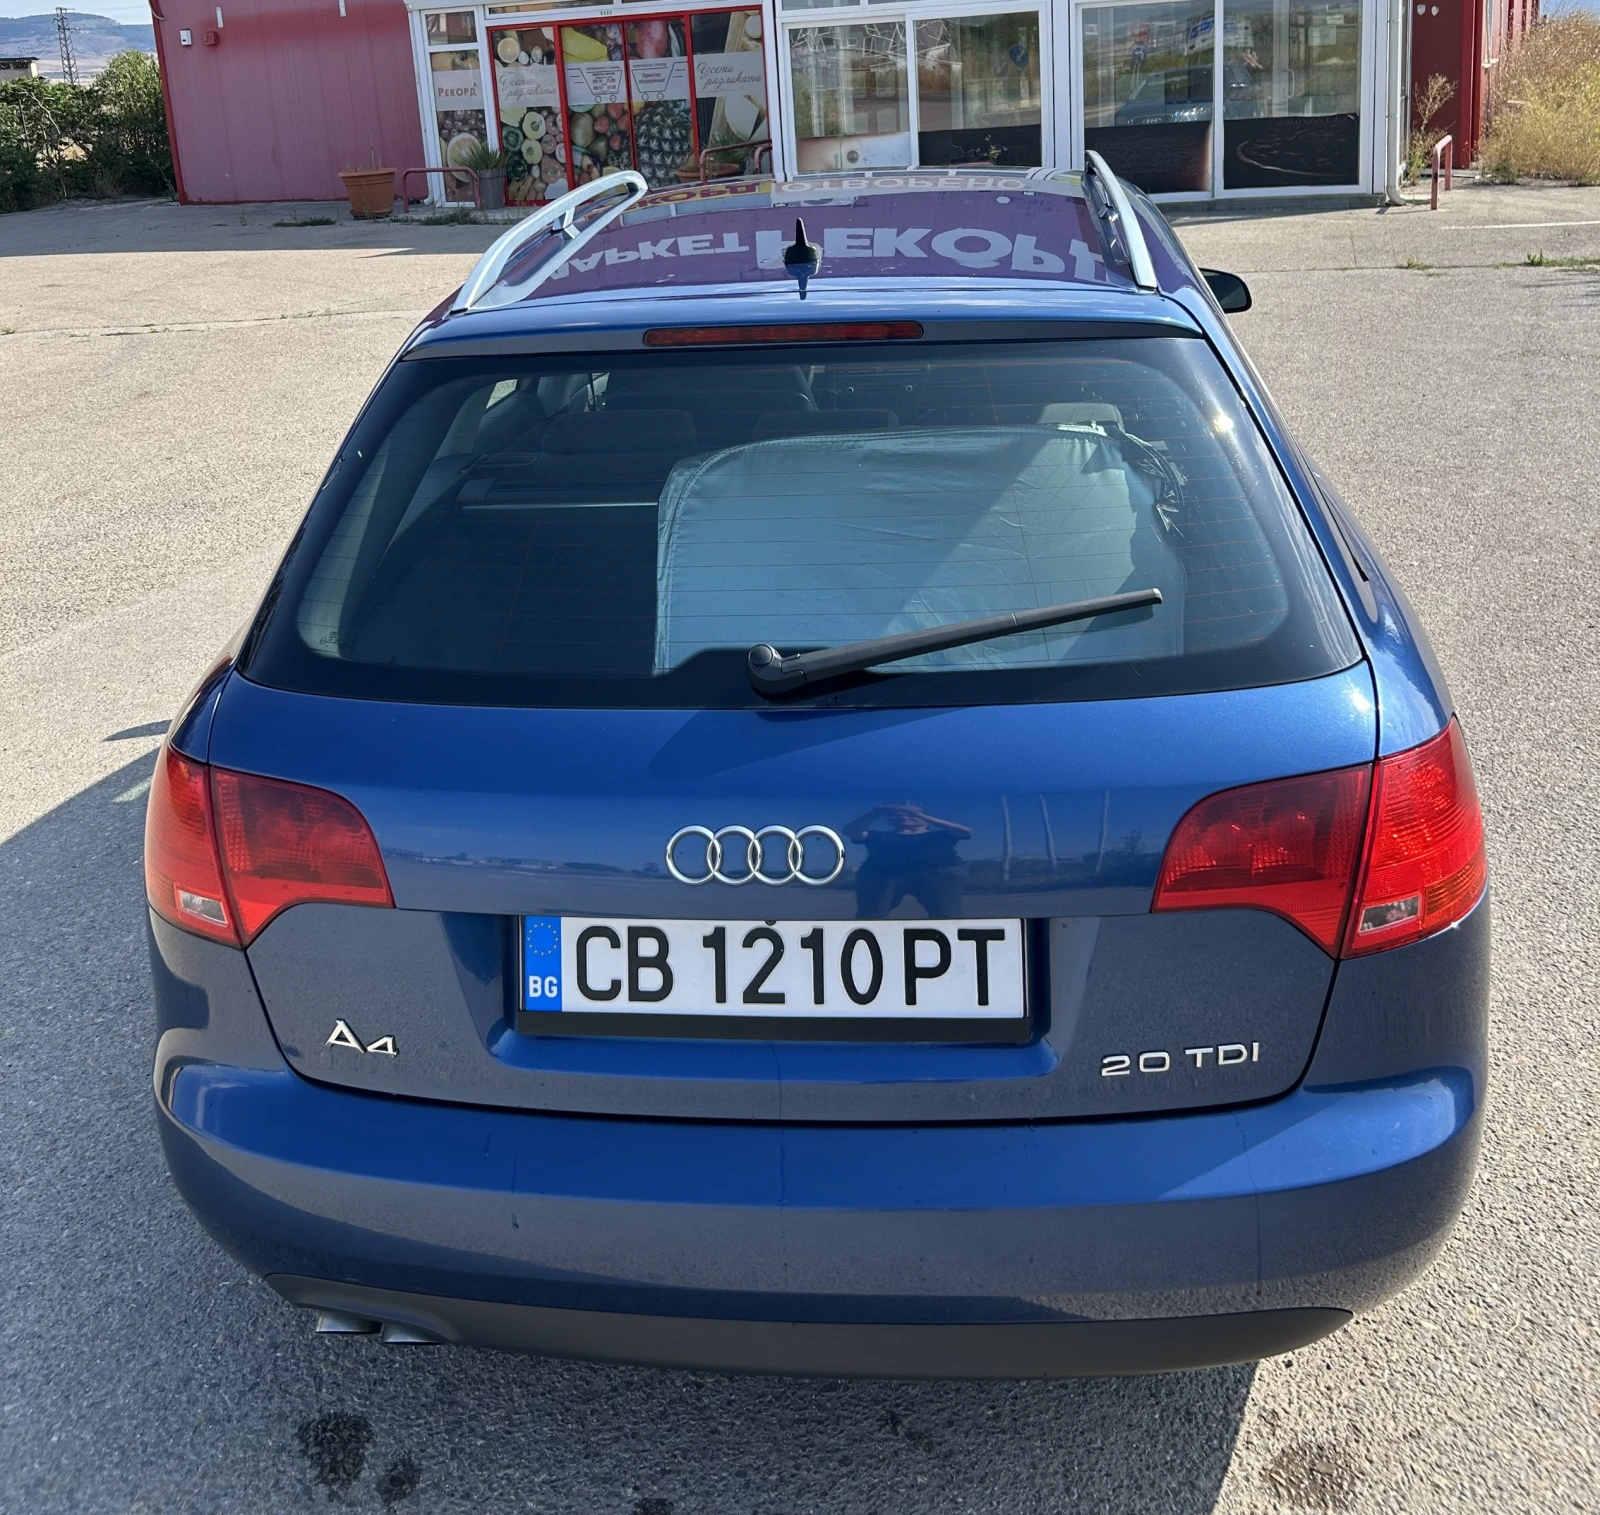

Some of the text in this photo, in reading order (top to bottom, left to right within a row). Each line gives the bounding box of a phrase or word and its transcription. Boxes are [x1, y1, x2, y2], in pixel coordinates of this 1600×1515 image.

[697, 62, 735, 80] Усети
[702, 71, 762, 90] разликата
[500, 75, 534, 91] Усети
[575, 925, 1006, 1007] CB 1210 PT
[528, 975, 558, 998] BG
[325, 1018, 398, 1058] A4
[1184, 1041, 1259, 1067] TDI
